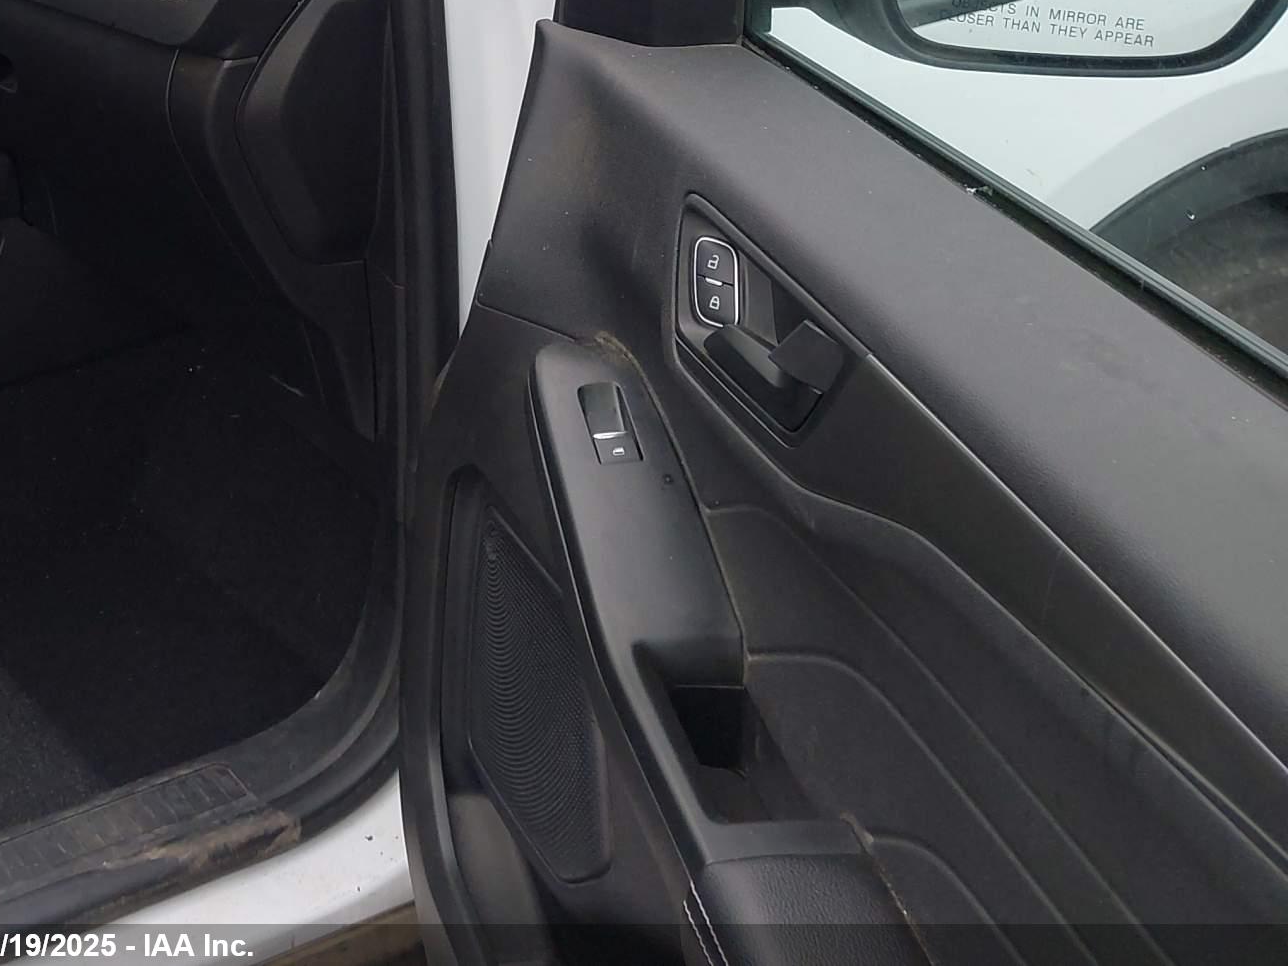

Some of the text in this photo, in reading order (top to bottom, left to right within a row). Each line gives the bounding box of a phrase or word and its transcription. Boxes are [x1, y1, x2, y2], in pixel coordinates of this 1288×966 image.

[1025, 4, 1041, 19] IN
[1049, 8, 1107, 26] MIRROR
[1115, 16, 1145, 31] ARE
[1003, 17, 1041, 33] THAN
[1050, 23, 1088, 39] THEY
[1094, 29, 1154, 47] APPEAR
